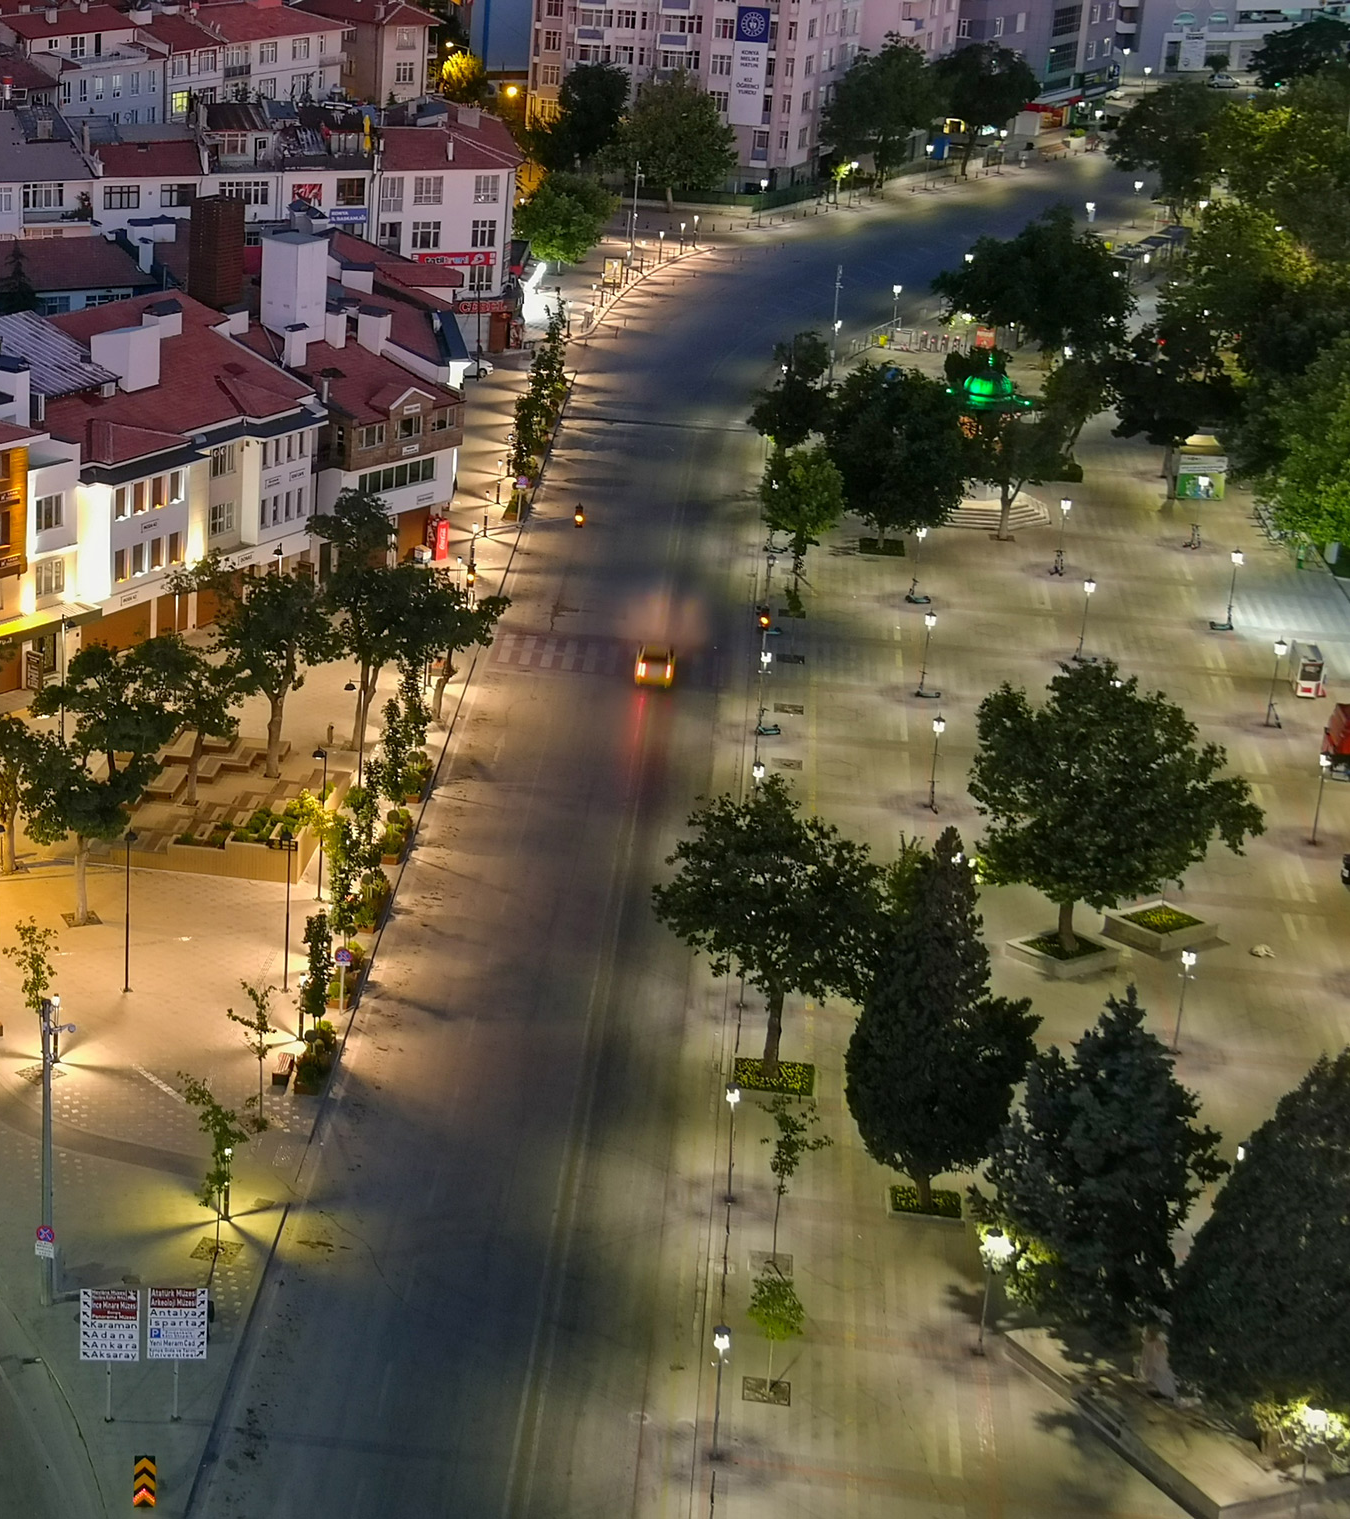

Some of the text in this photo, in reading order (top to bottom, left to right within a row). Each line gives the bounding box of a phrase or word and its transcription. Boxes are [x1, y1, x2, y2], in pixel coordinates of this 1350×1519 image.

[150, 1309, 197, 1319] Antalya
[91, 1321, 137, 1329] Karaman
[150, 1319, 197, 1328] Isparta
[91, 1331, 134, 1339] Adana
[91, 1341, 137, 1349] Ankara
[91, 1350, 137, 1360] Aksaray
